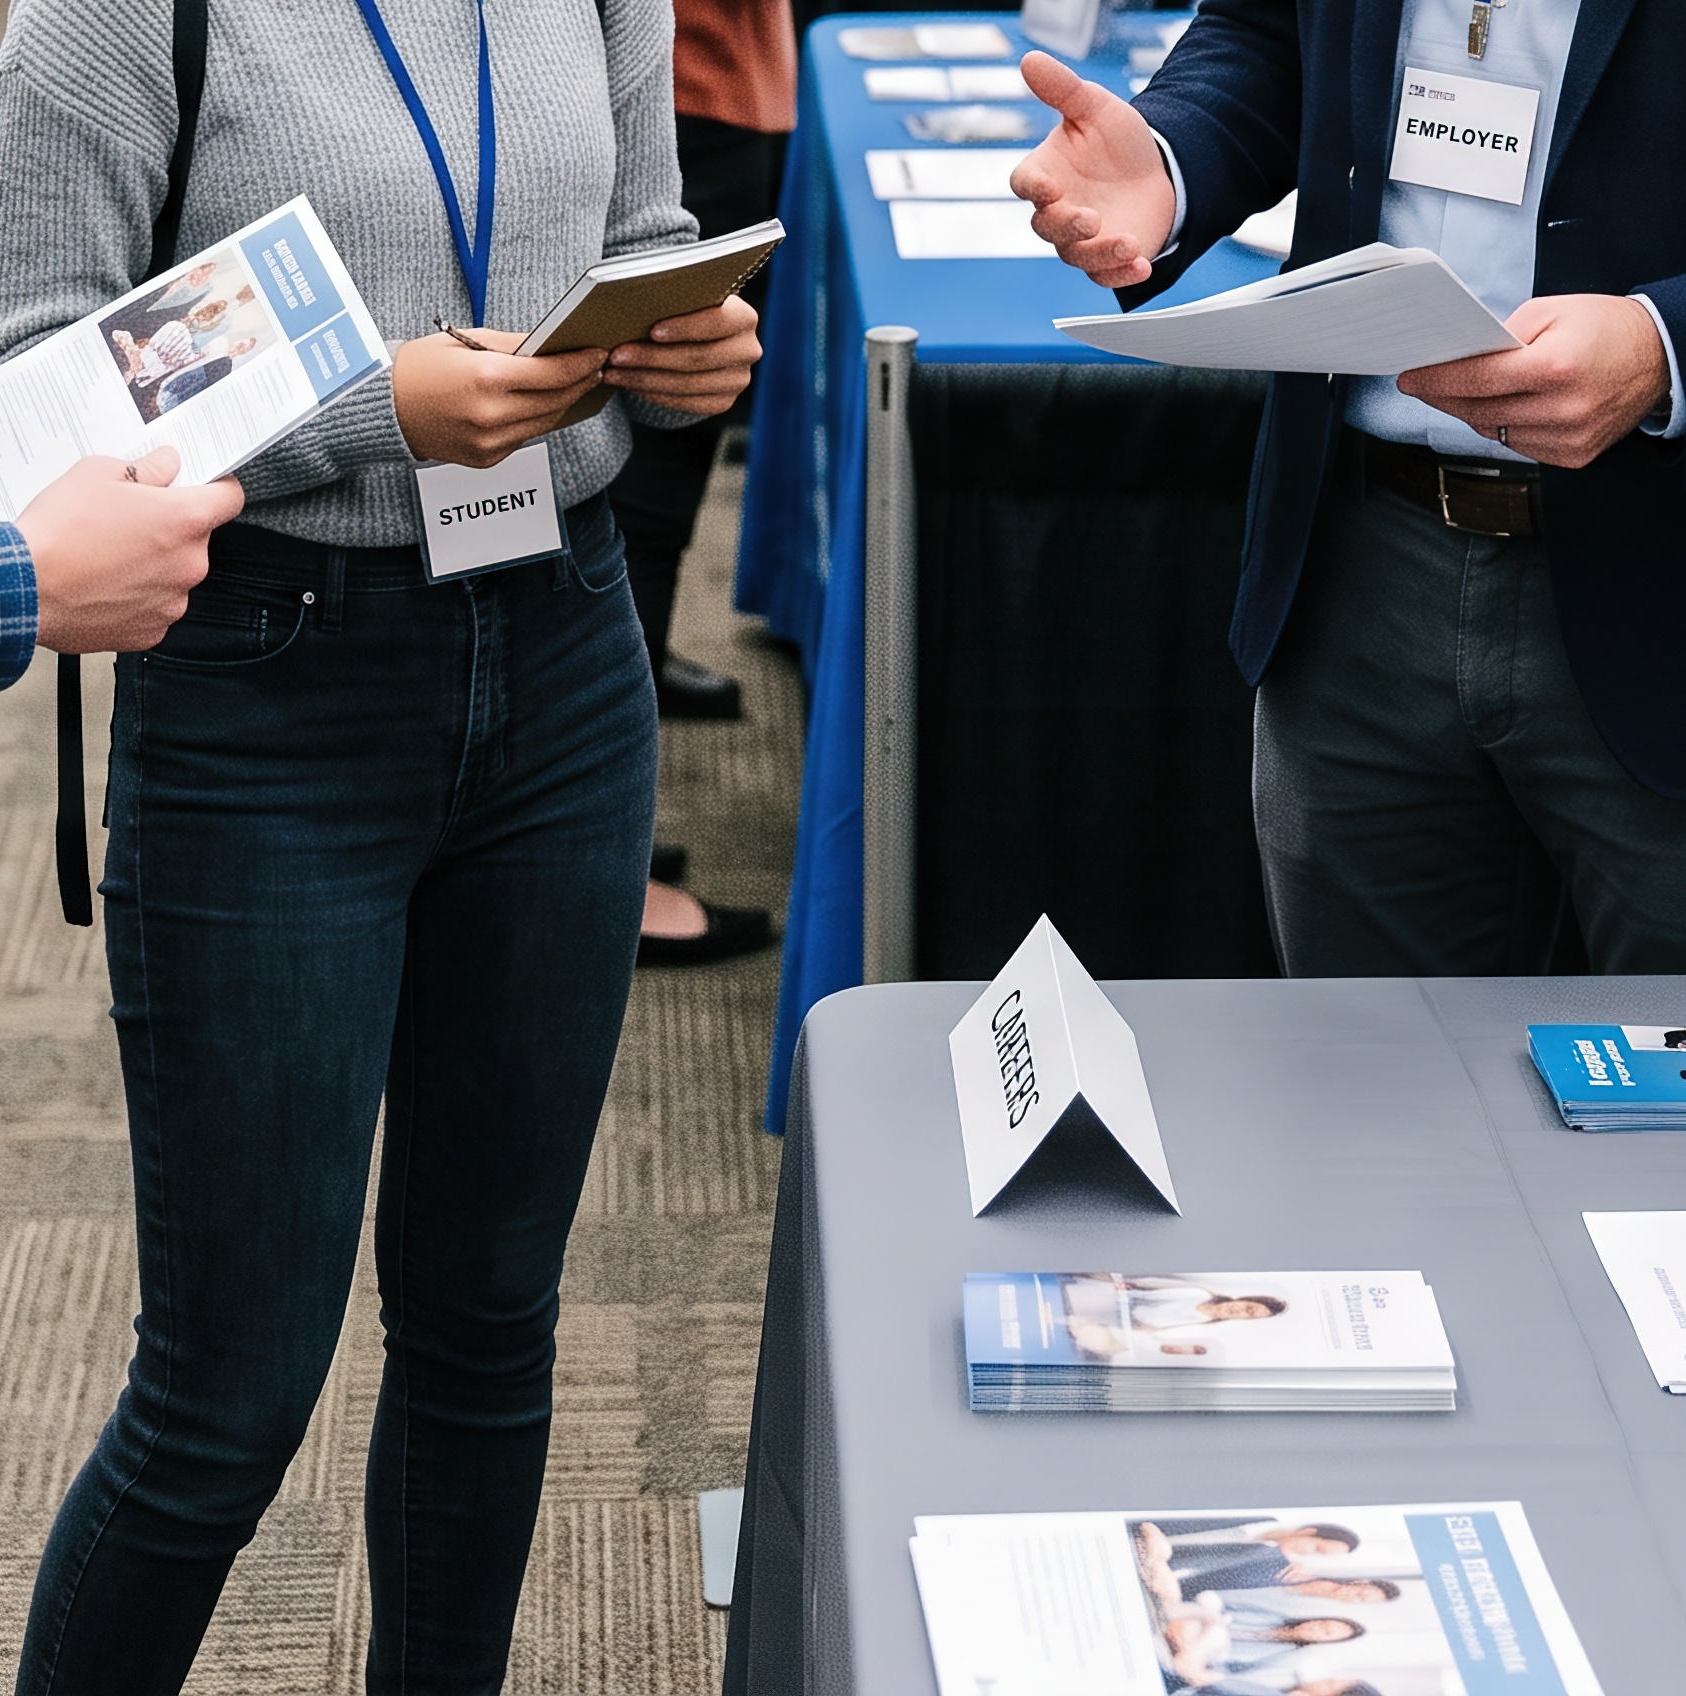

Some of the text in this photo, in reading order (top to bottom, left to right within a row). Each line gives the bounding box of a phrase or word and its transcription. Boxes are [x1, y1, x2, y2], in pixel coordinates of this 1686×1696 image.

[1406, 118, 1519, 153] EMPLOYER
[439, 488, 538, 526] STUDENT
[991, 989, 1040, 1129] CAREERS
